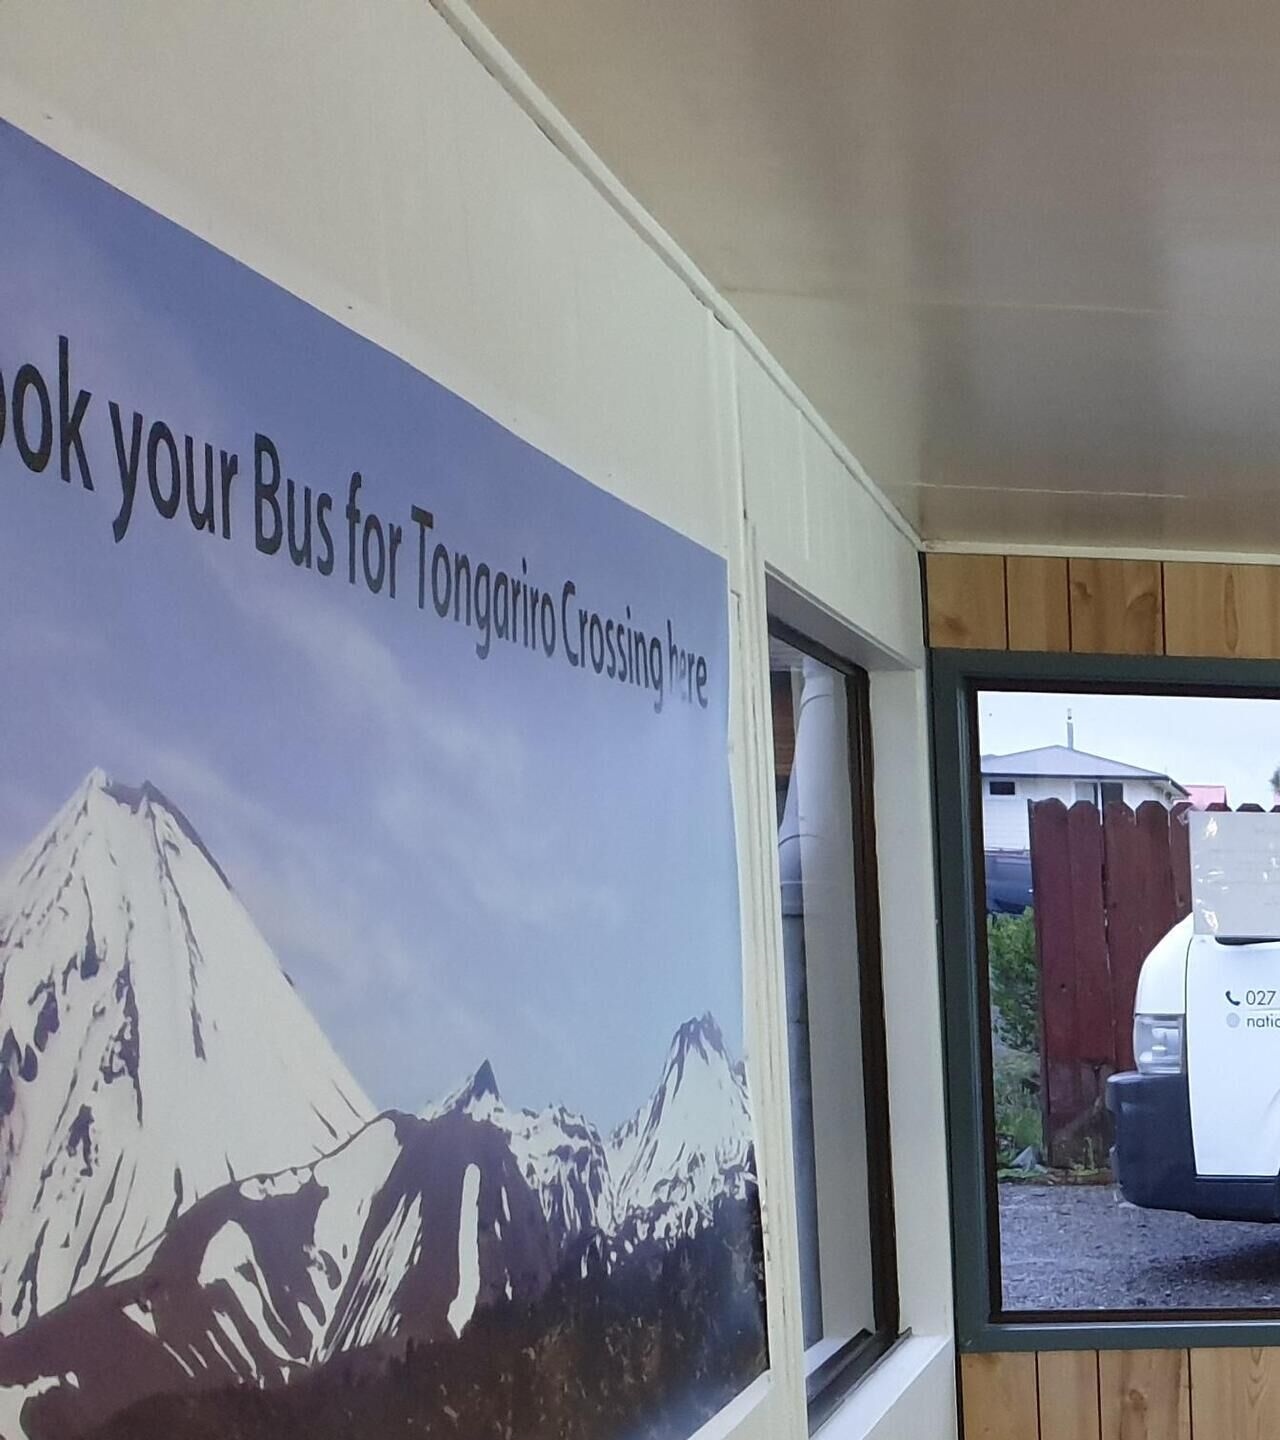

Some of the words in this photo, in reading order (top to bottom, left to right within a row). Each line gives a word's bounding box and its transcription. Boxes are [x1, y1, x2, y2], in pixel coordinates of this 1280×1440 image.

[0, 335, 95, 492] ok
[108, 400, 238, 543] your
[255, 432, 335, 577] Bus
[345, 471, 402, 598] for
[411, 504, 556, 661] Tongariro
[561, 580, 663, 714] Crossing
[1245, 990, 1277, 1006] 027
